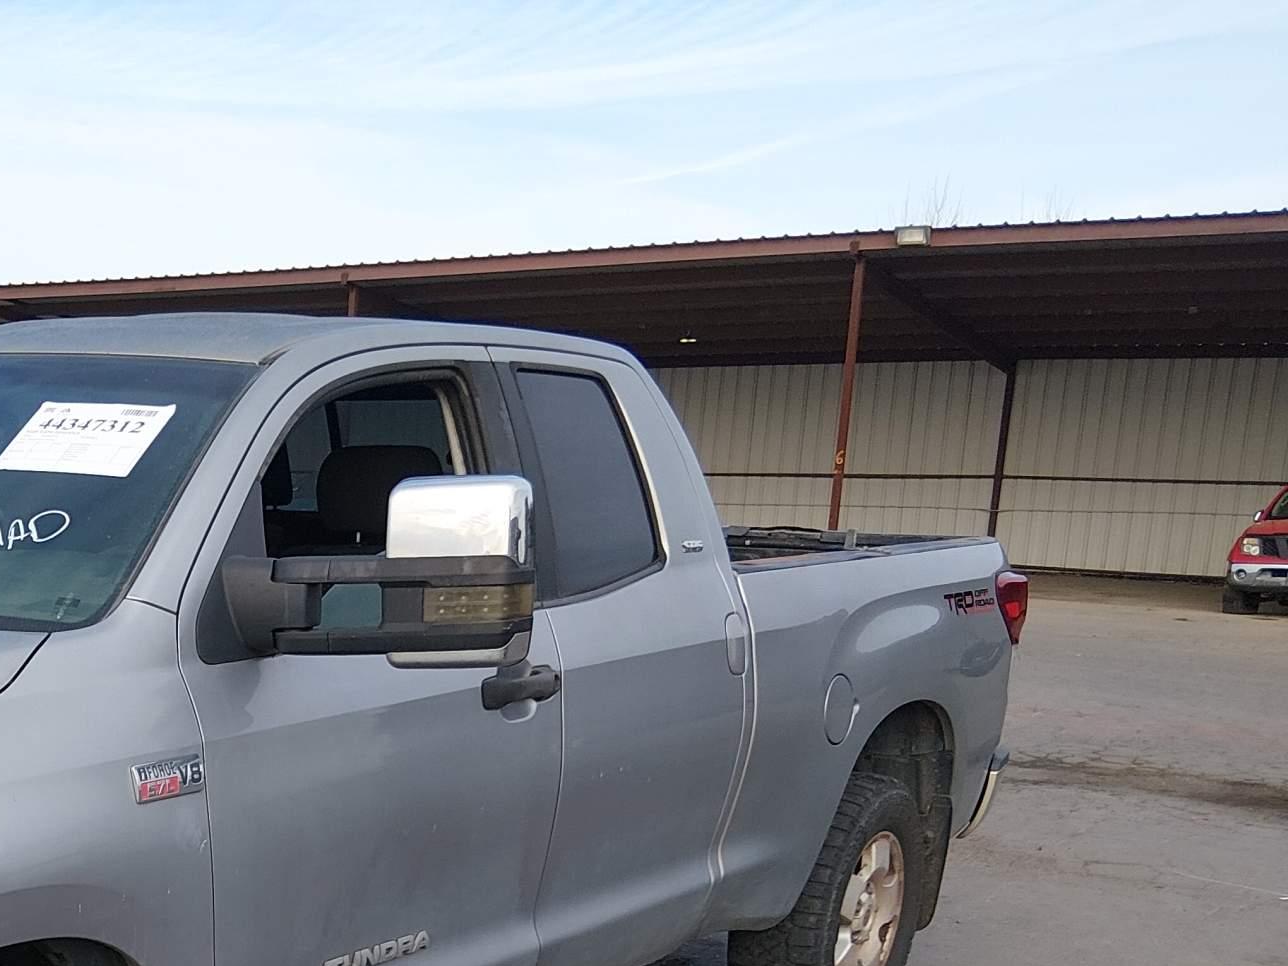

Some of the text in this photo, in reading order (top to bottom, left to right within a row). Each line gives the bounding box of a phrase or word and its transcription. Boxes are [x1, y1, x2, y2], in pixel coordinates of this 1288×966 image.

[39, 418, 145, 434] 44347312
[943, 591, 974, 616] TRD
[178, 761, 202, 786] V8
